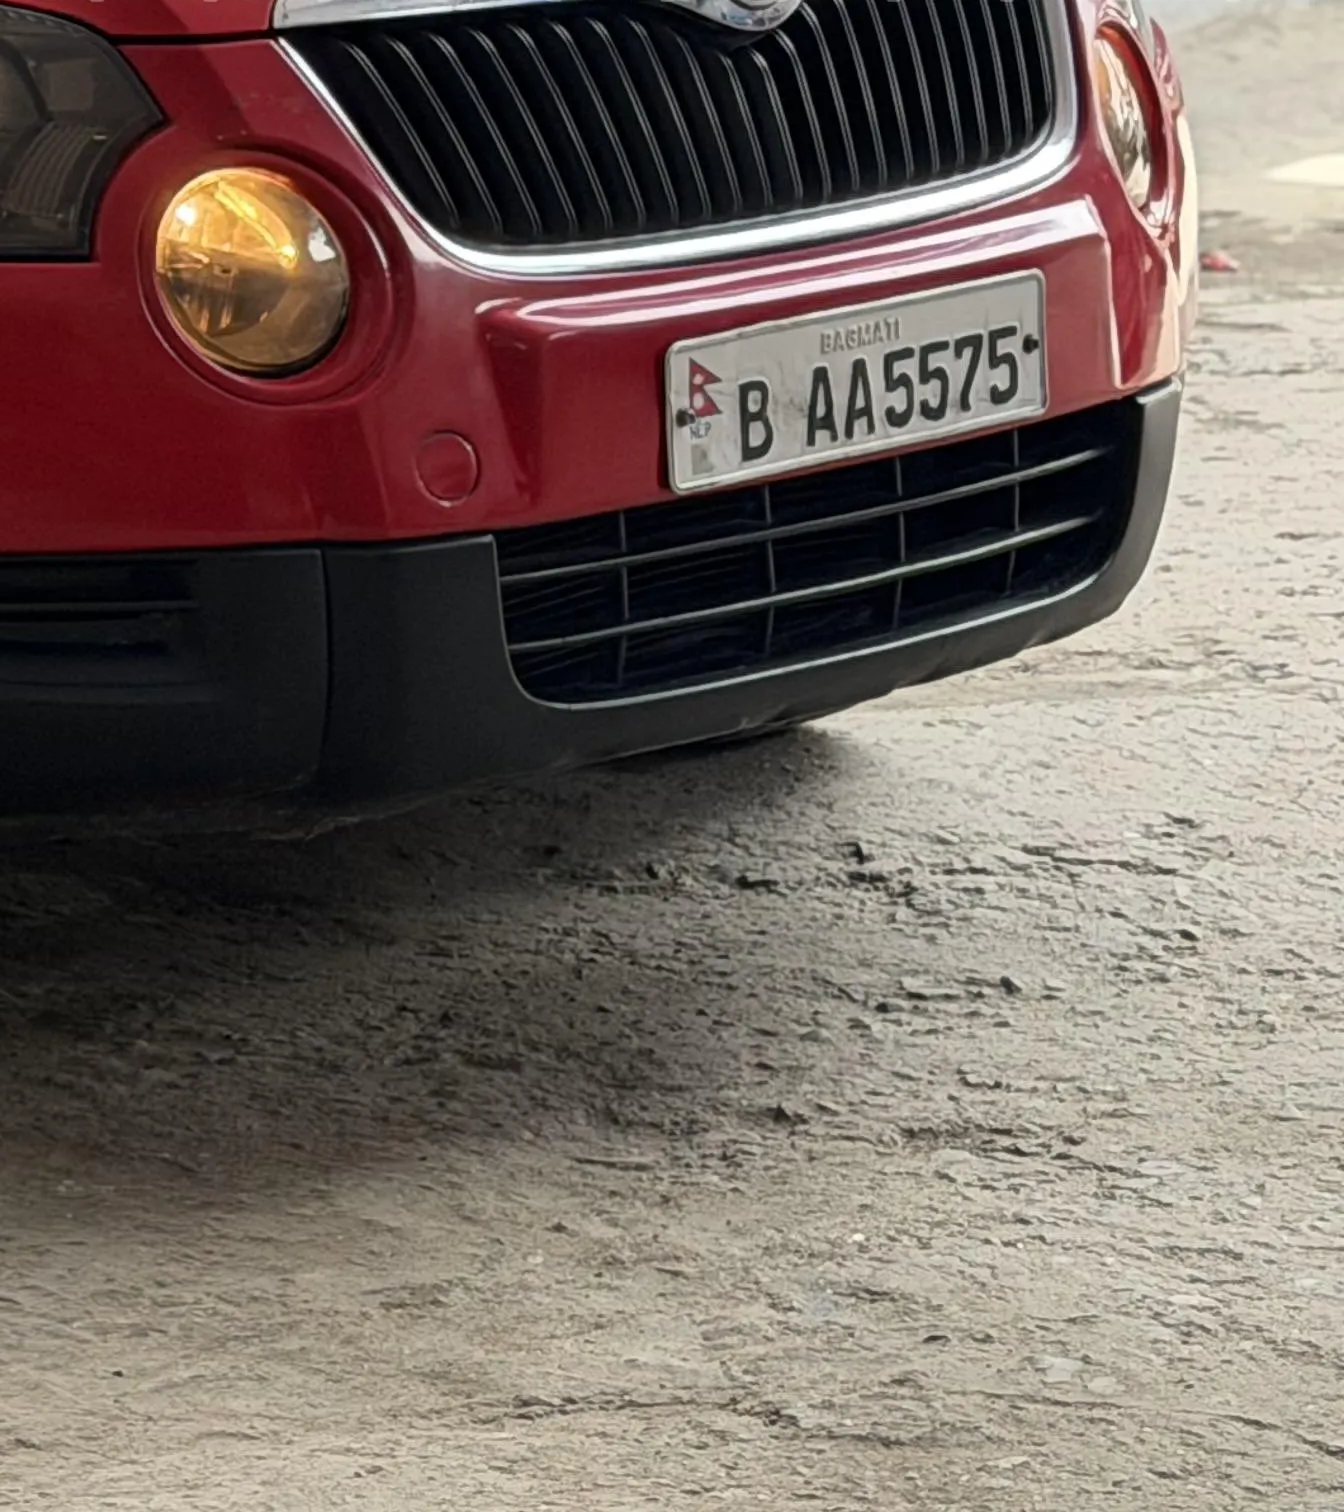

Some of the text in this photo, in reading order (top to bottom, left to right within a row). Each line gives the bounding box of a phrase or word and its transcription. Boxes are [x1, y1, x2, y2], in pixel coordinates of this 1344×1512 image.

[820, 318, 900, 355] BAGMATI
[738, 325, 1018, 463] B AA5575
